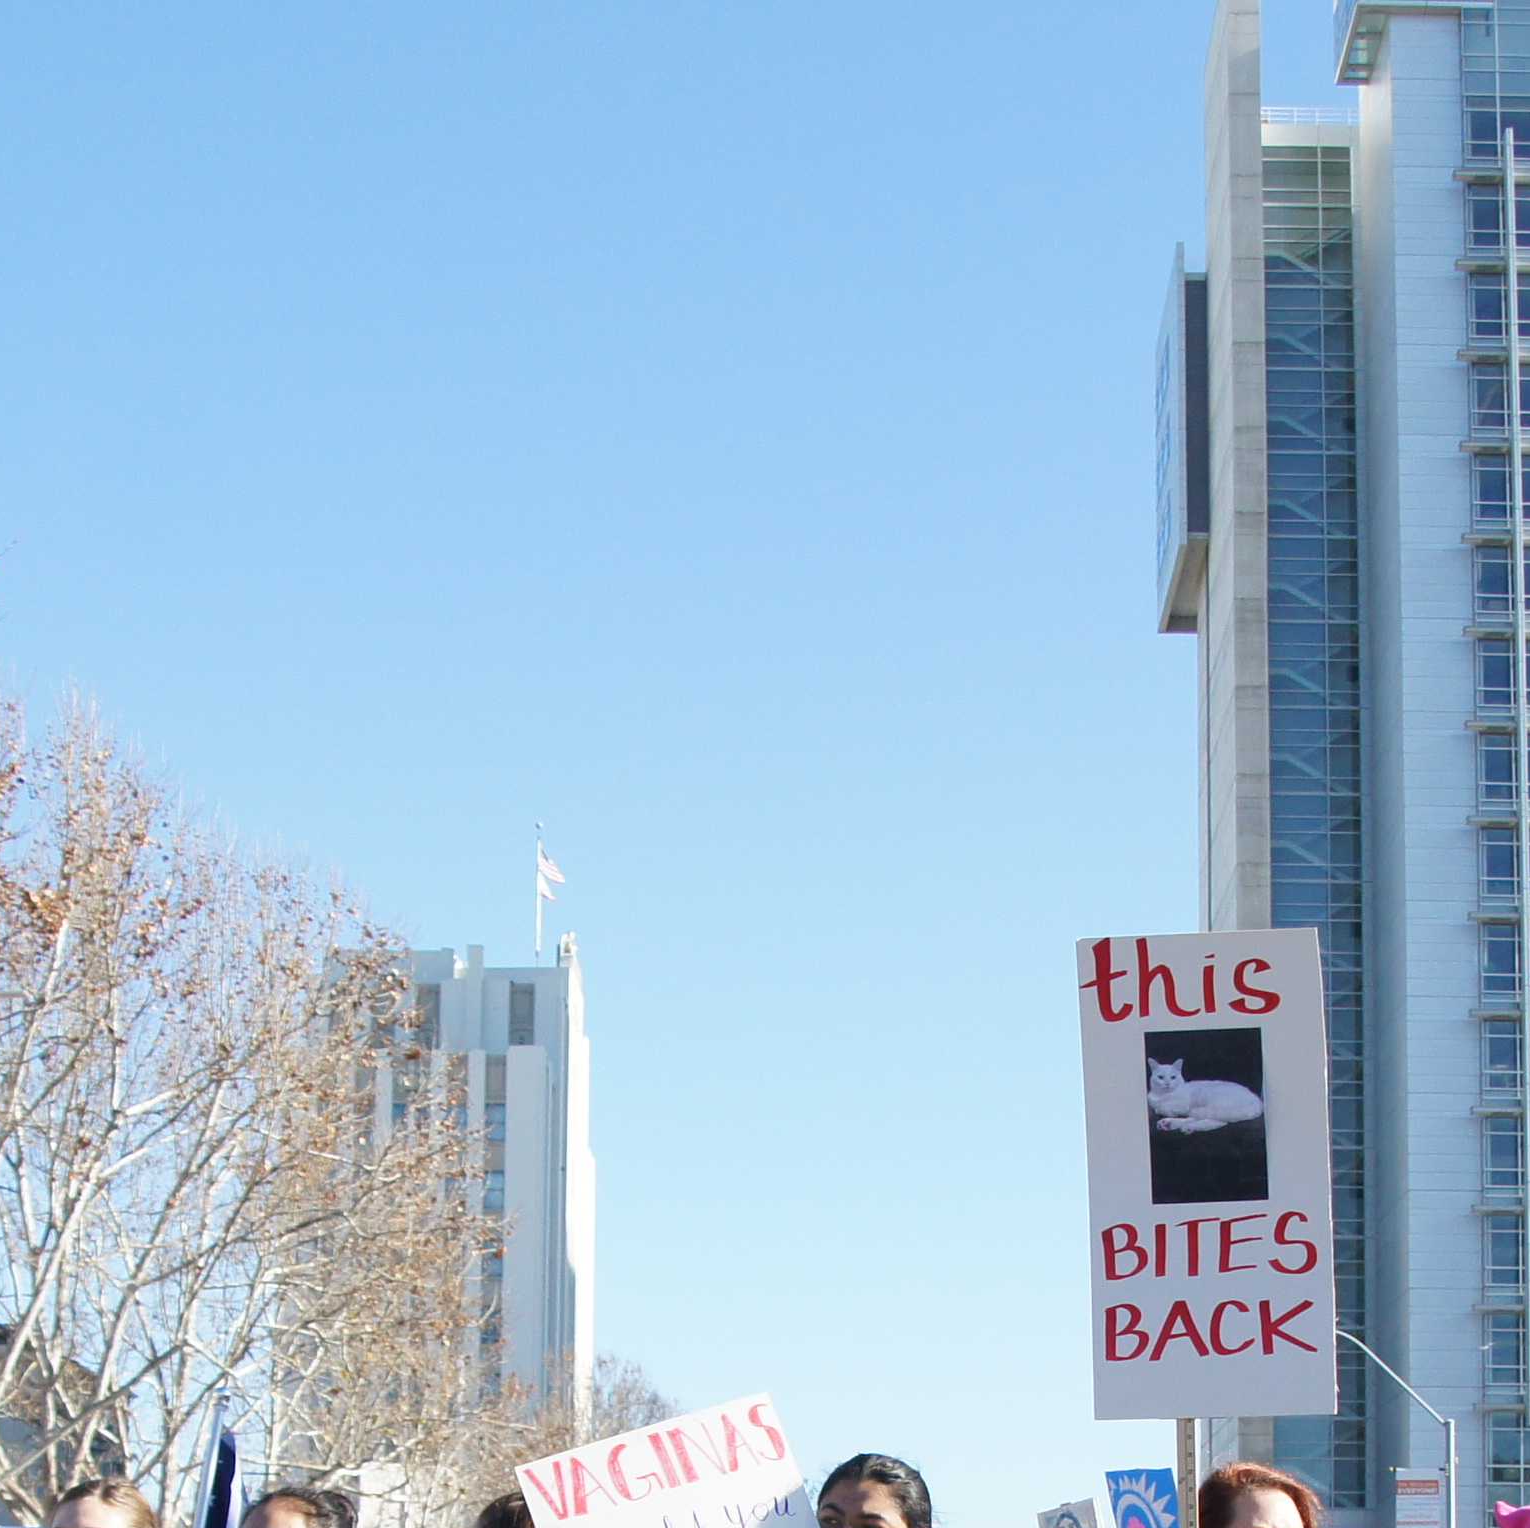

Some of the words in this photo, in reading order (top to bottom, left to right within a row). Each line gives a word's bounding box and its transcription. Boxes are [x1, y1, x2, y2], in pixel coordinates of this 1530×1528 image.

[1080, 936, 1281, 1022] this
[1101, 1210, 1318, 1281] BITES
[1104, 1300, 1318, 1362] BACK
[524, 1403, 786, 1521] VAGINAS
